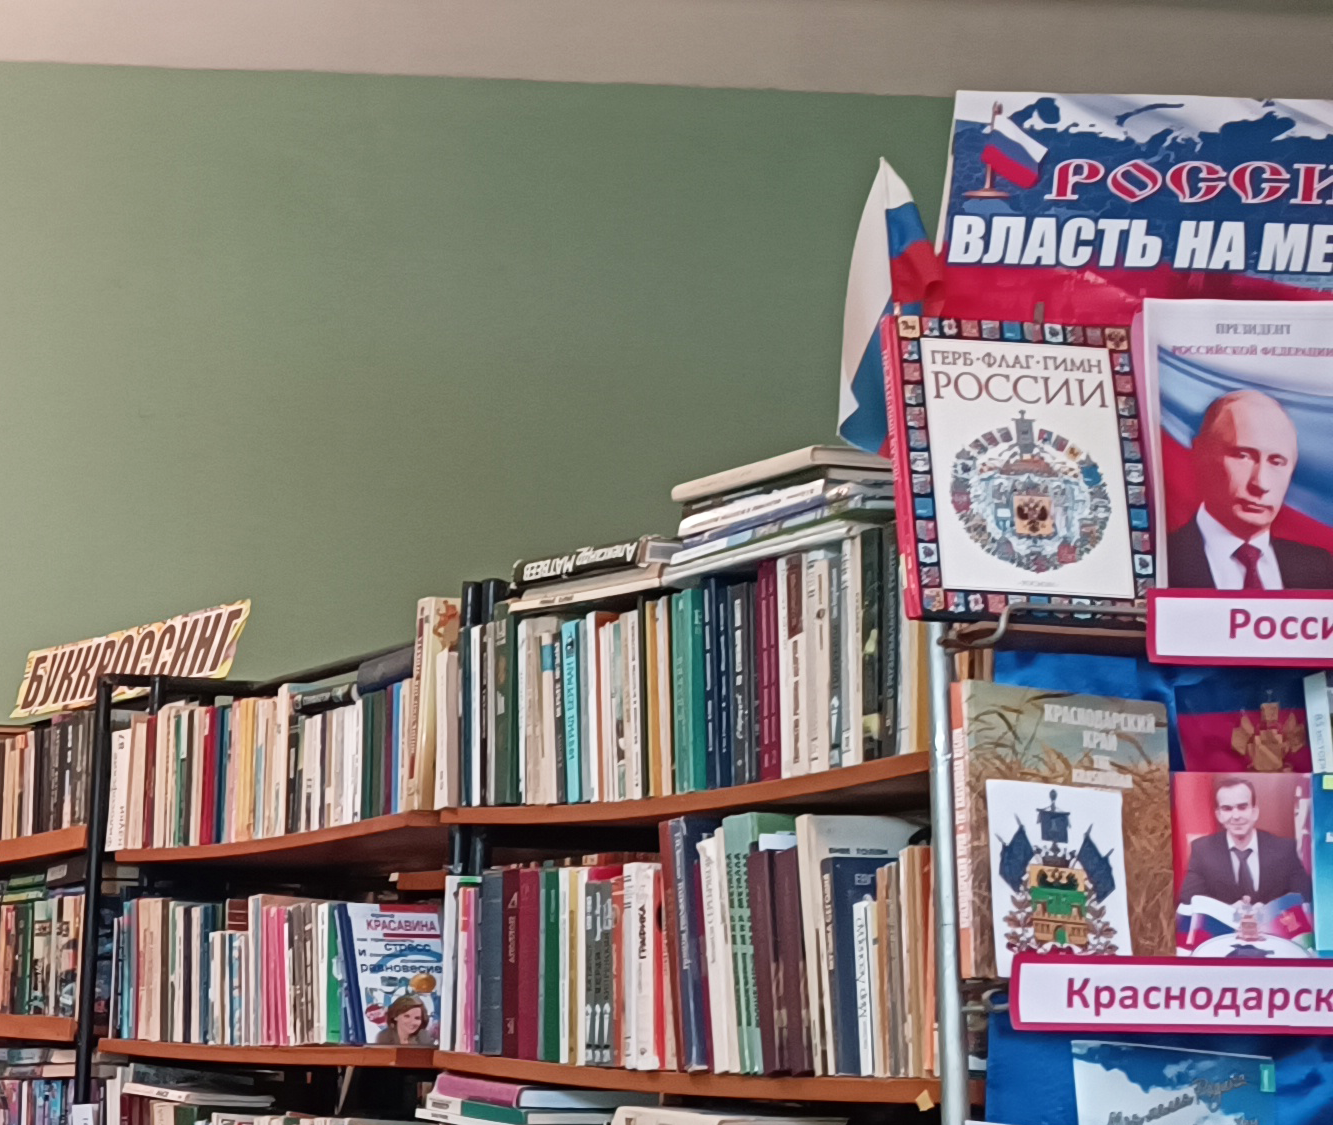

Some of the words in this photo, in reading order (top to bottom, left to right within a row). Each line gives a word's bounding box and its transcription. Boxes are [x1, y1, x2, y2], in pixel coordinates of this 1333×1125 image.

[947, 214, 1164, 267] ВЛАСТЬ
[1174, 220, 1246, 270] НА
[1215, 322, 1292, 336] ПРЕЗИДЕНТ
[1172, 344, 1258, 356] РОССИЙСКОЙ
[931, 371, 1109, 409] РОССИИ
[521, 554, 576, 581] МАТВЕЕВ
[19, 606, 245, 711] БУККРОССИНГ
[1043, 703, 1156, 734] КРАСНОДАРСКИЙ
[1082, 729, 1119, 752] КРАЙ
[366, 918, 438, 932] КРАСАВИНА
[638, 903, 647, 960] ГРАФИКА
[1066, 975, 1333, 1018] Краснодарск
